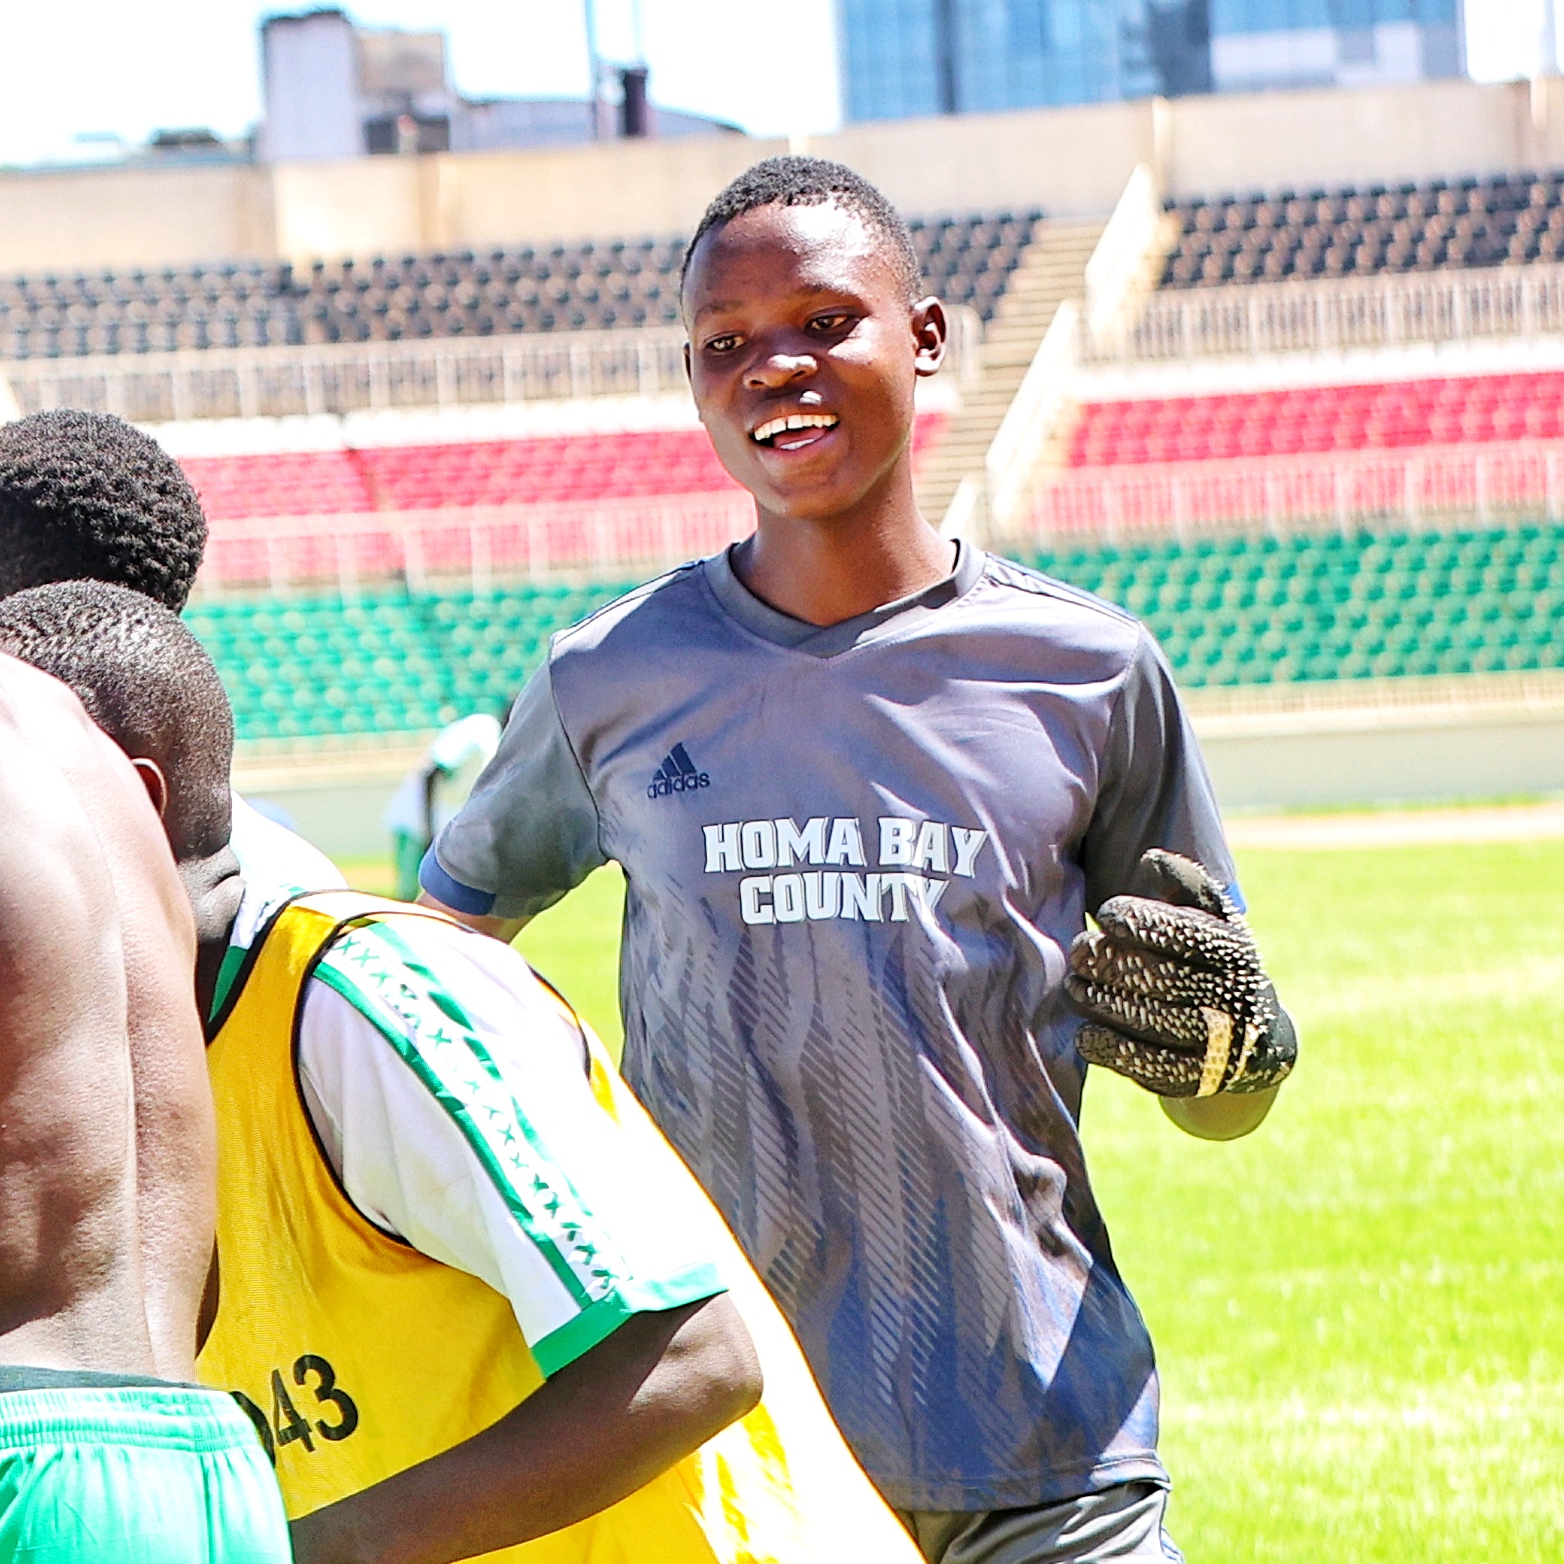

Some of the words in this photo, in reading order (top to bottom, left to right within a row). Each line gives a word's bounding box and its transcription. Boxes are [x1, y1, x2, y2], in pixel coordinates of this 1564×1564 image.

[646, 771, 711, 799] adidas
[702, 816, 868, 873] HOMA
[878, 816, 988, 879] BAY
[740, 870, 950, 925] COUNTY
